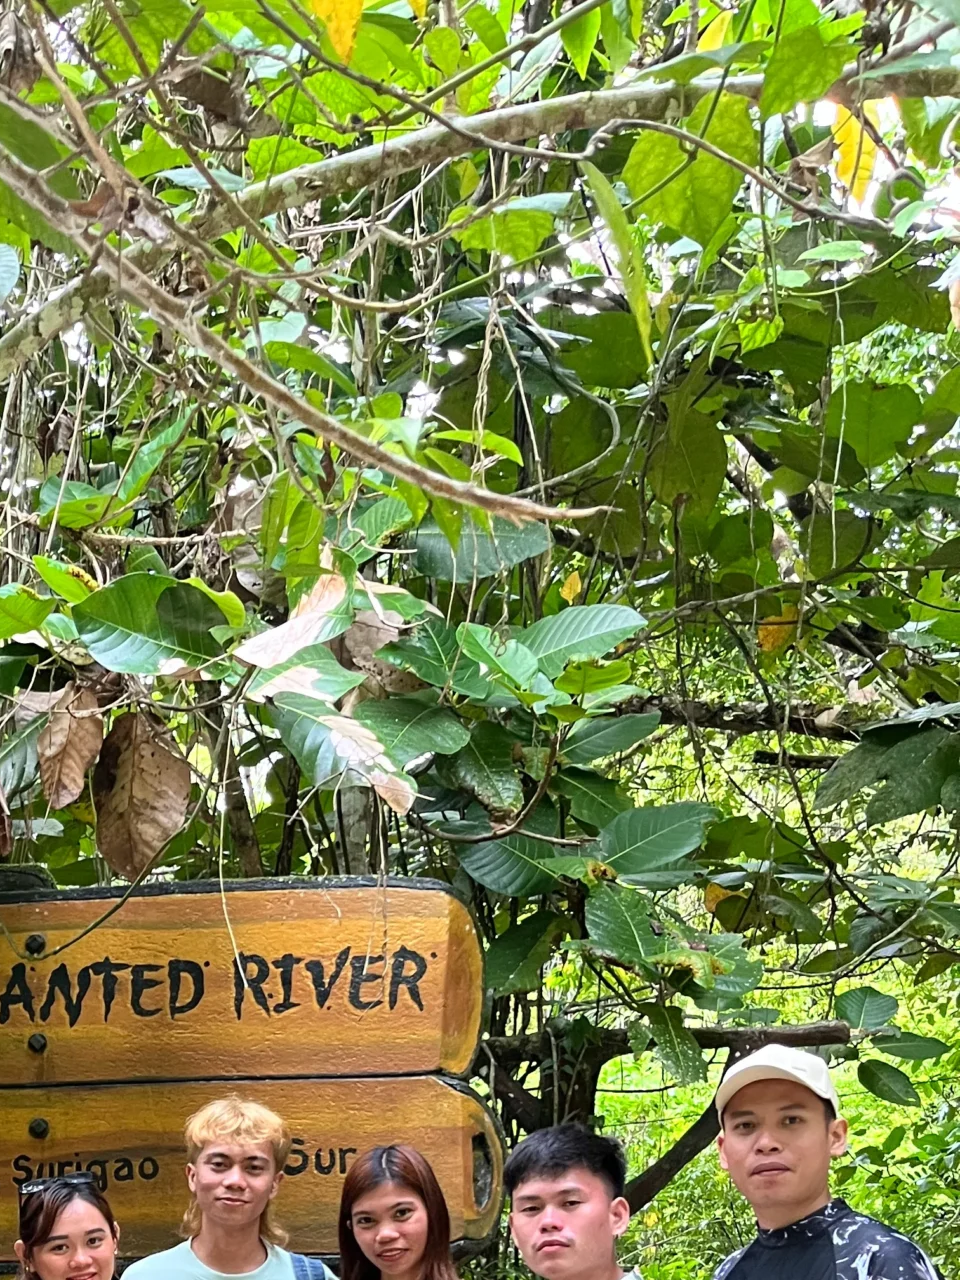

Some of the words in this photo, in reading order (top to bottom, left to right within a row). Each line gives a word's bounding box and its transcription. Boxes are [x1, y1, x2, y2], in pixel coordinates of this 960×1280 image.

[232, 944, 428, 1021] RIVER
[12, 1152, 159, 1193] Surigao
[283, 1137, 358, 1176] Sur
